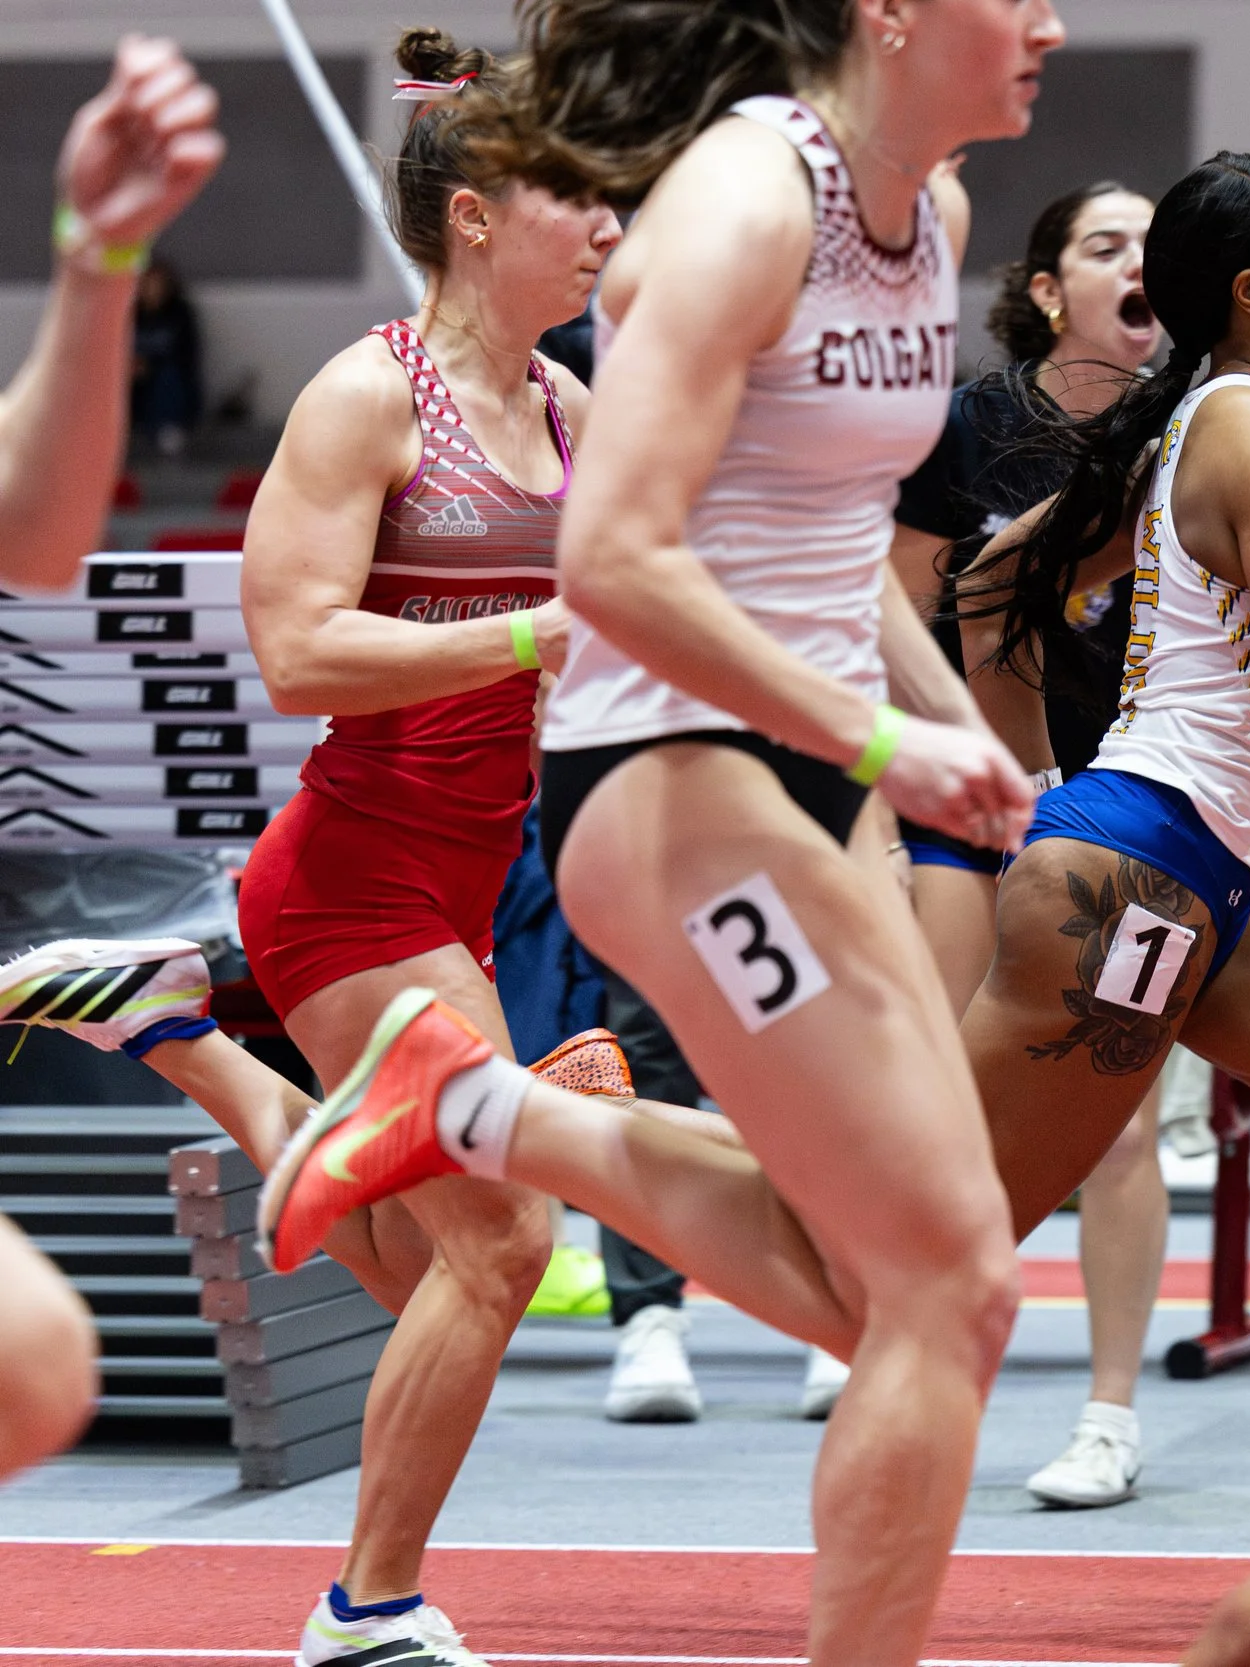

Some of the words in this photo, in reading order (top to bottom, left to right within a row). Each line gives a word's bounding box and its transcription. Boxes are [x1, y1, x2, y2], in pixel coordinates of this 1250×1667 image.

[418, 520, 488, 536] adidas
[709, 899, 797, 1015] 3
[1135, 925, 1171, 1005] 1
